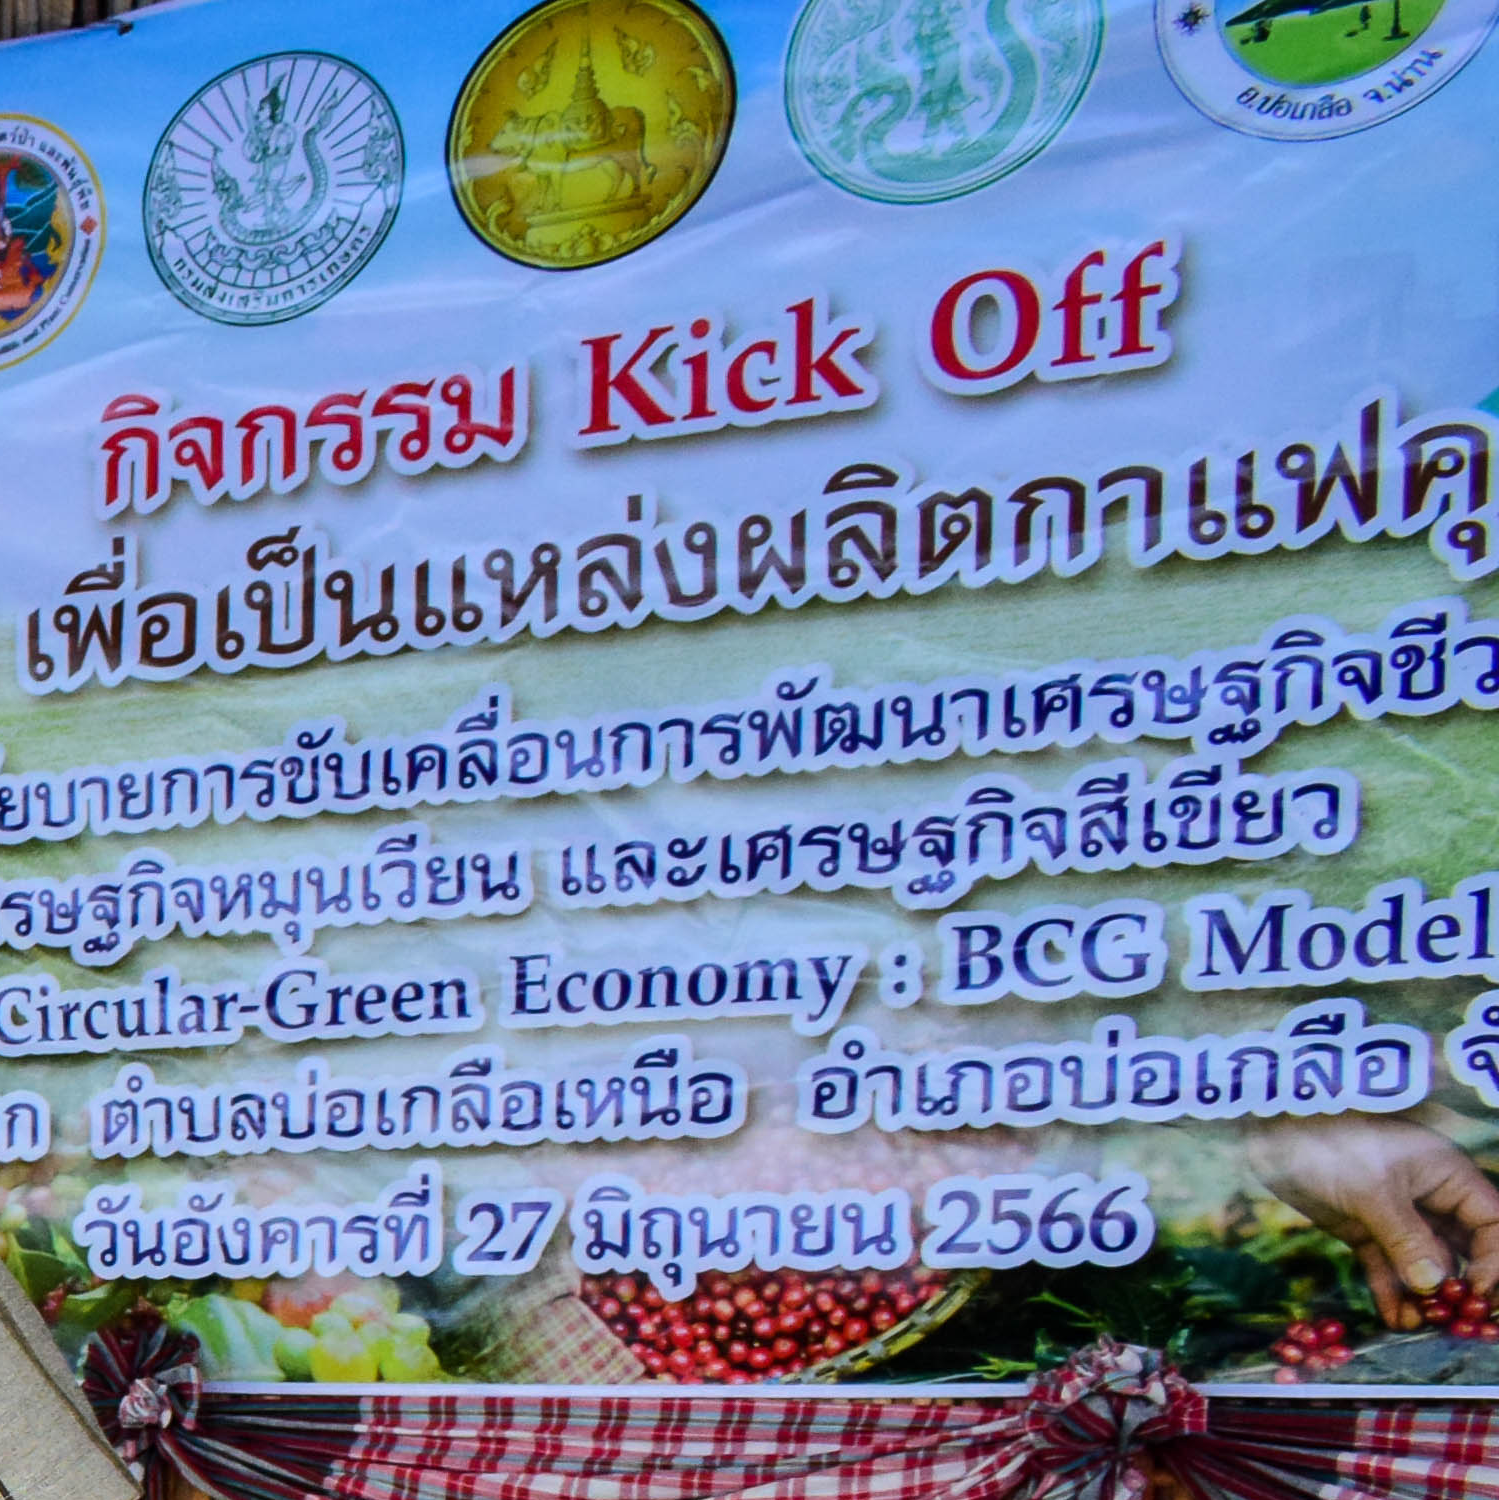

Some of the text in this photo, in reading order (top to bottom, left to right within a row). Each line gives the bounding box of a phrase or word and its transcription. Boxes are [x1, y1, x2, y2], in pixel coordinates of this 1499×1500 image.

[579, 240, 1167, 436] Kick Off
[101, 366, 516, 507] กิจกรรม
[25, 400, 1489, 682] เพื่อเป็นแหล่งผลิตกาแฟคุ
[561, 764, 1341, 896] และเศรษฐกิจสีเขียว
[510, 952, 852, 1022] Economy
[893, 953, 910, 994] :
[952, 912, 1153, 992] BCG
[1197, 886, 1496, 977] Model
[103, 1047, 733, 1145] ตำบลบ่อเกลือเหนือ
[811, 1012, 1412, 1121] อำเภอบ่อเกลือ
[85, 1173, 1139, 1286] วันอังคารที่ 27 มิถุนายน 2566
